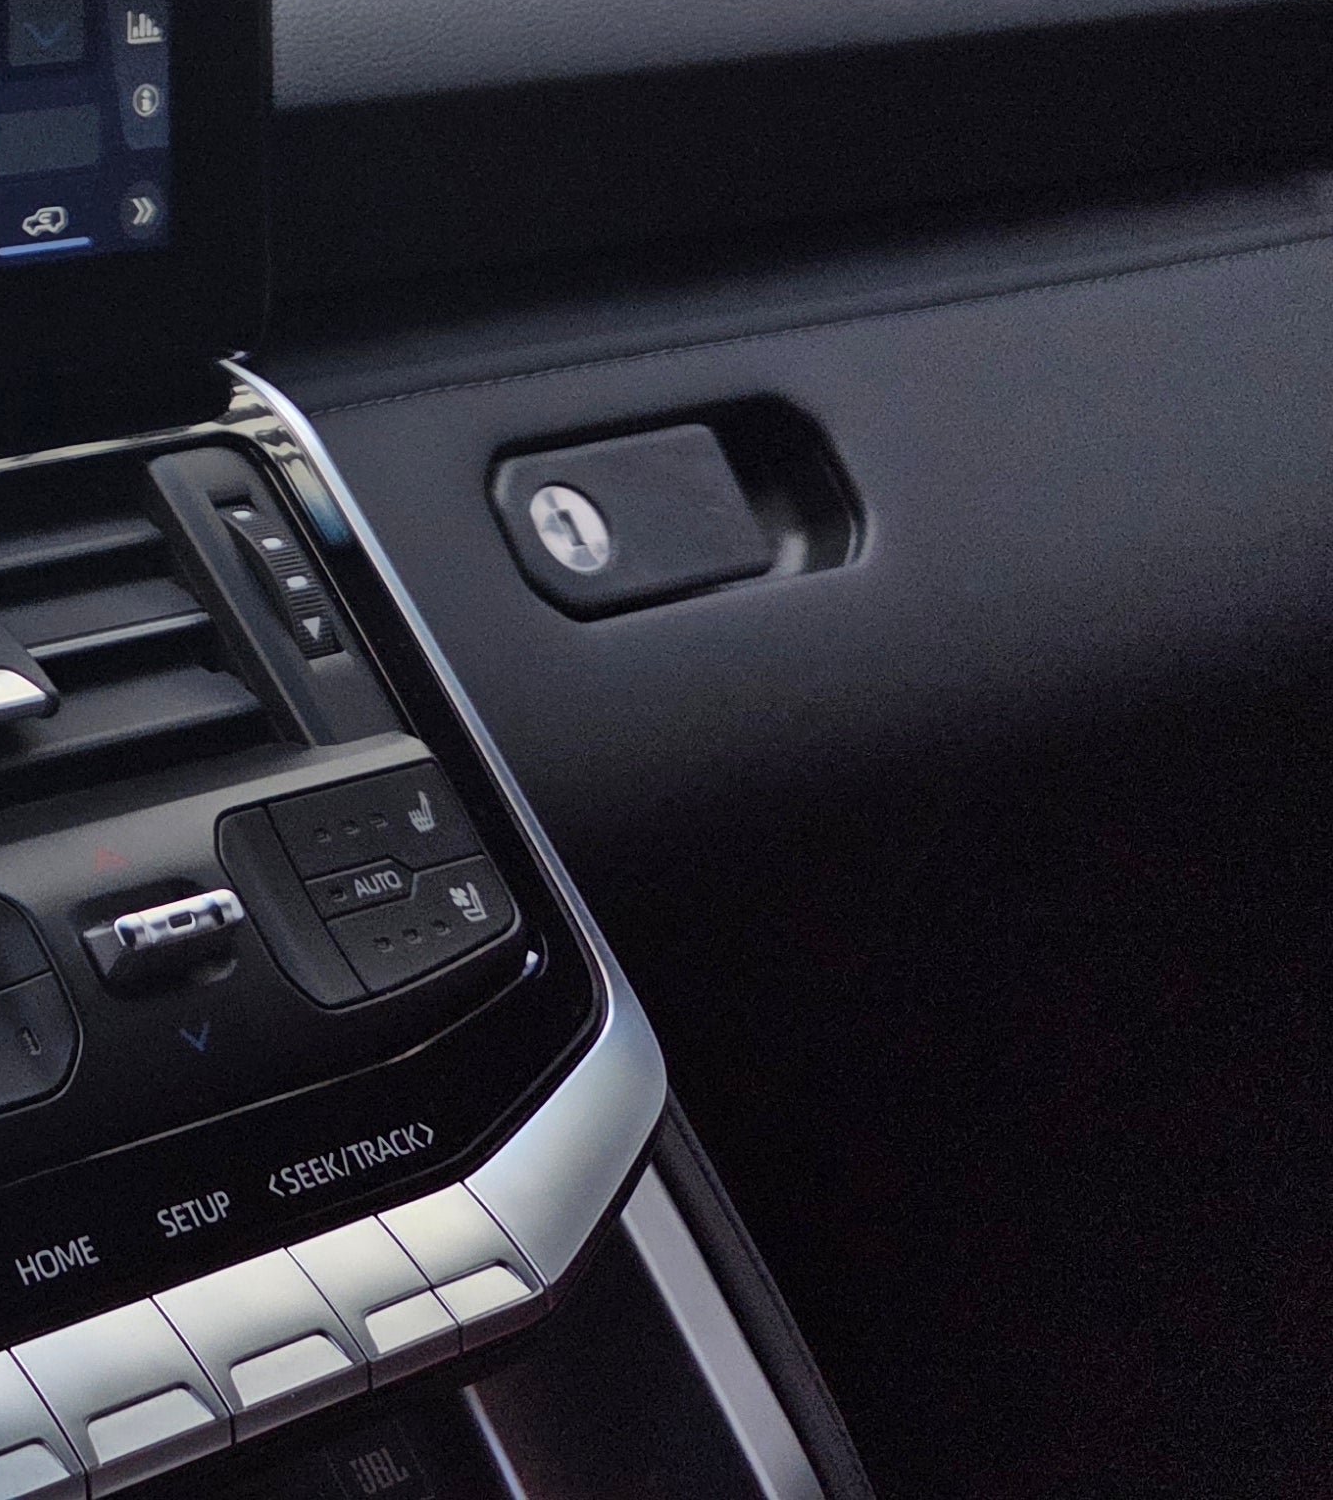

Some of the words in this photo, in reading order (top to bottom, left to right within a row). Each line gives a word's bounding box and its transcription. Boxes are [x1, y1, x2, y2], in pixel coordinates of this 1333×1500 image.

[354, 869, 403, 900] AUTO
[157, 1189, 232, 1239] SETUP
[14, 1234, 101, 1286] HOME
